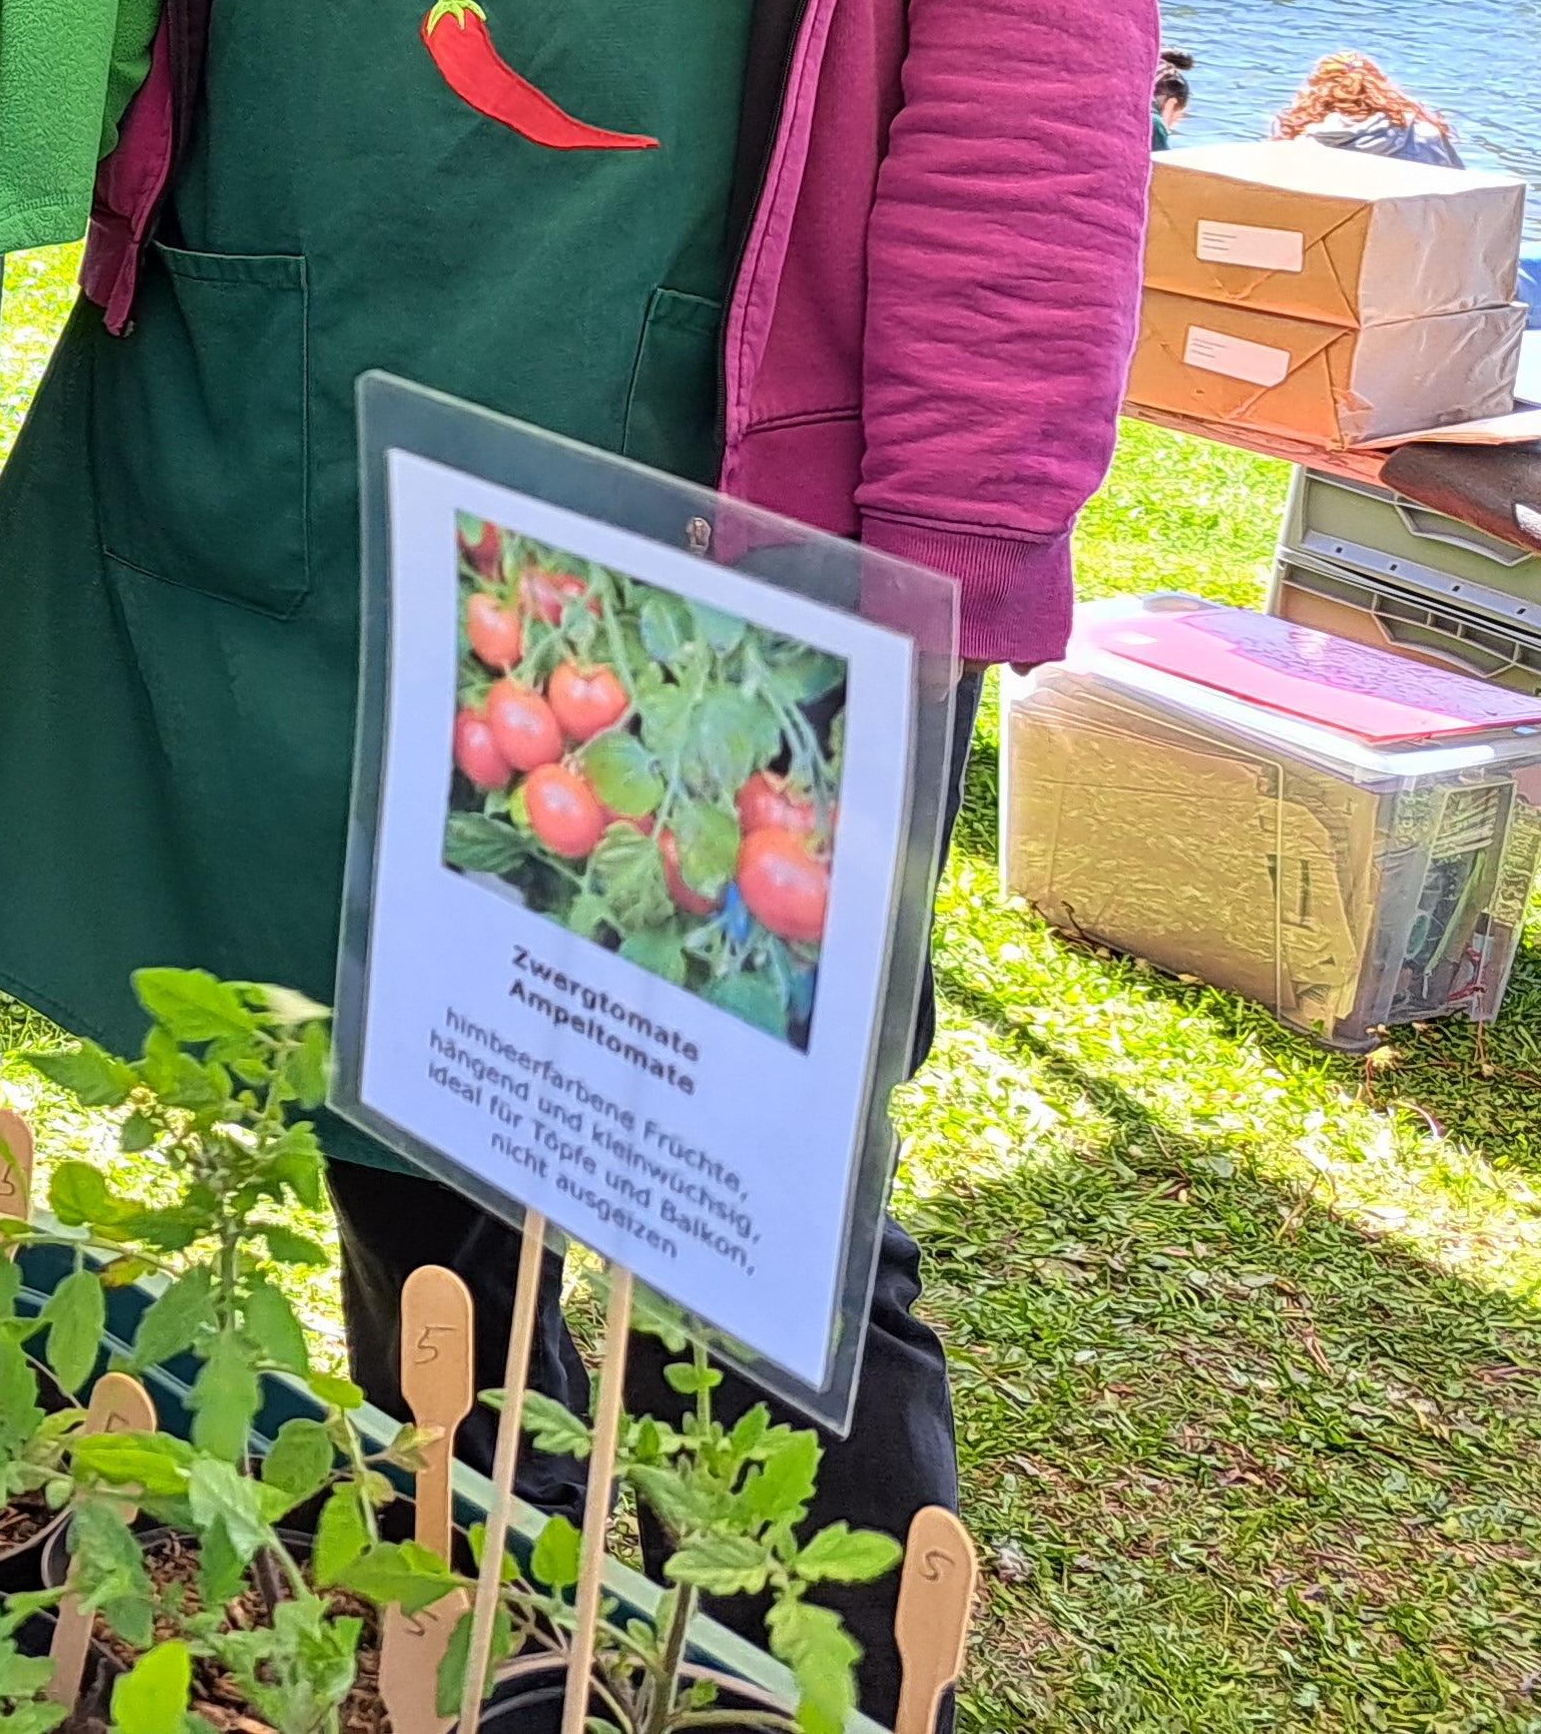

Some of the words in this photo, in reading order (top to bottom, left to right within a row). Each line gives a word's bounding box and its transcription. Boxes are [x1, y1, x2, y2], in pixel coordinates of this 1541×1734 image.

[508, 977, 697, 1097] Ampeltomate
[512, 943, 701, 1063] Zwergtomate
[429, 1029, 530, 1102] hängend
[537, 1094, 584, 1134] und
[591, 1120, 763, 1246] kleinwüchsig,
[445, 1006, 639, 1134] himbeerfarbene
[642, 1119, 751, 1203] Früchte,
[427, 1062, 483, 1108] ideal
[489, 1094, 524, 1130] für
[531, 1117, 599, 1176] Töpfe
[604, 1170, 653, 1211] und
[658, 1197, 757, 1278] Balkon,
[490, 1131, 550, 1179] nicht
[554, 1173, 680, 1261] ausgeizen
[415, 1325, 458, 1366] 5
